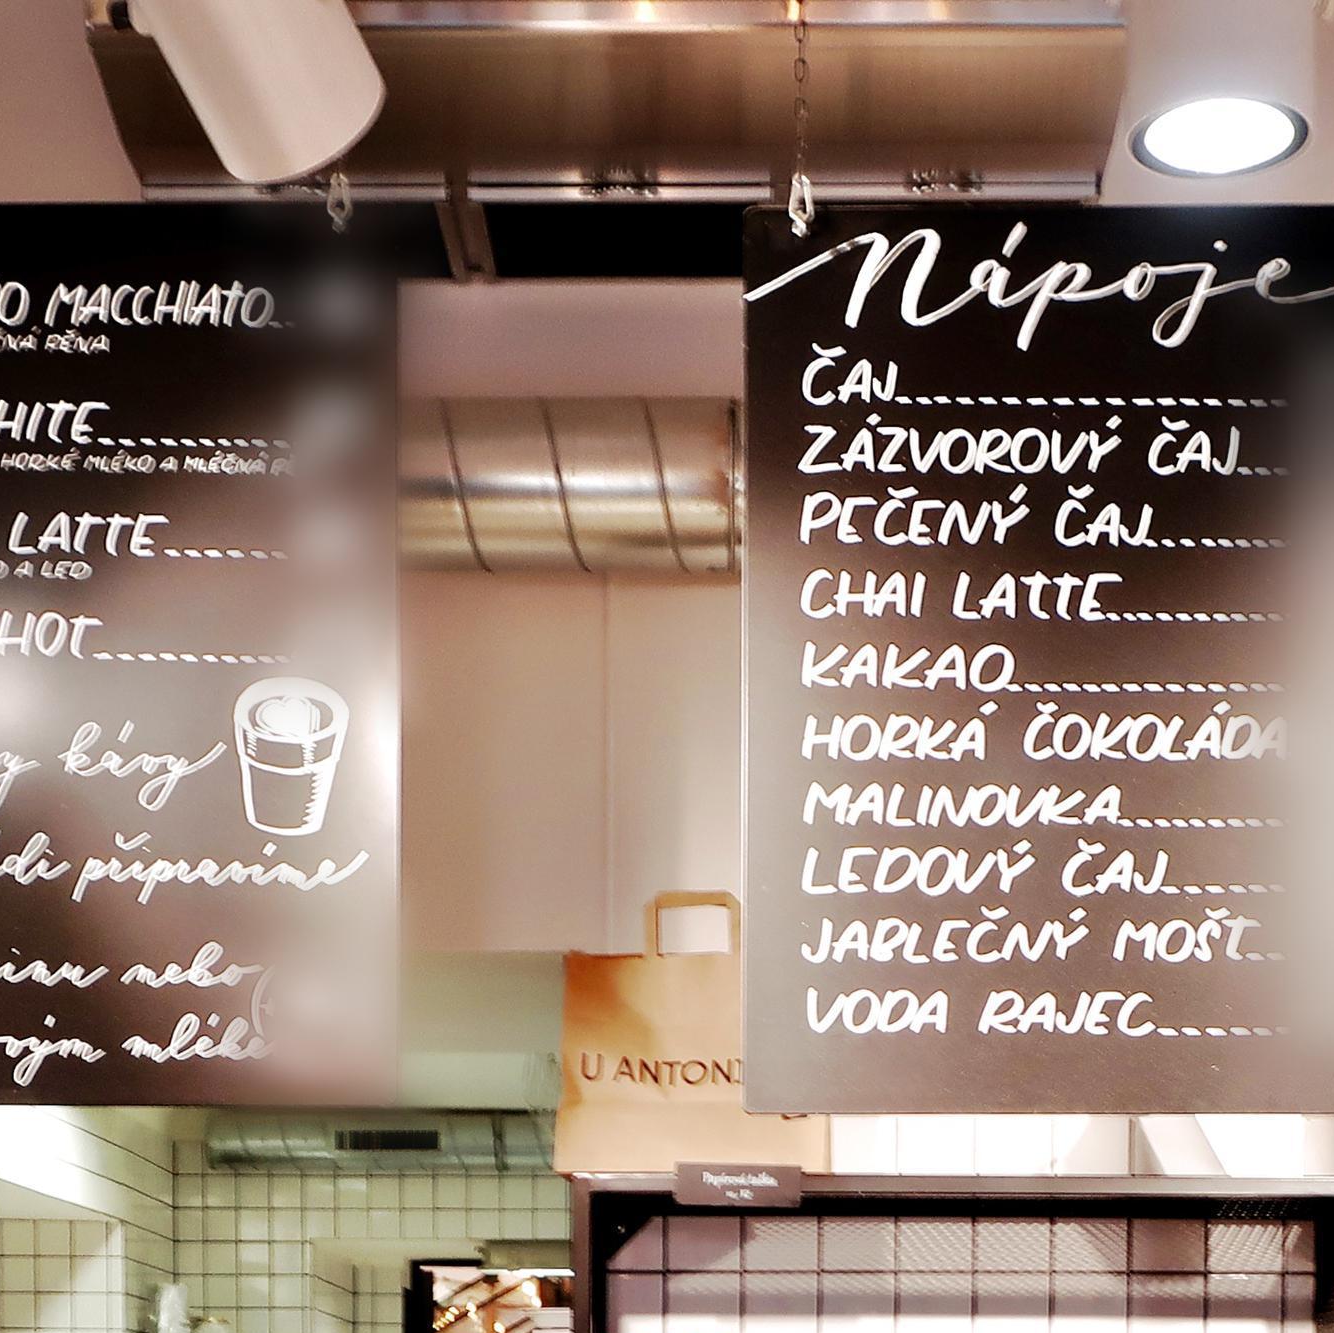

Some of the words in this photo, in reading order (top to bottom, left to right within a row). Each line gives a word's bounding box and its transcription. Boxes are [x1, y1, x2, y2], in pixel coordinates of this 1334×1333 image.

[44, 279, 275, 329] MACCHIATO
[45, 331, 110, 355] PĚNA
[801, 342, 898, 406] ČAJ
[0, 447, 81, 472] HORKÉ
[83, 449, 156, 474] MLÉKO
[159, 456, 178, 472] A
[796, 413, 1122, 475] ZÁZVOROVÝ
[1147, 416, 1239, 476] ČAJ
[8, 511, 170, 557] LATTE
[799, 484, 1029, 546] PEČENÝ
[1054, 484, 1155, 549] ČAJ
[14, 560, 34, 578] A
[40, 560, 93, 580] LED
[799, 569, 925, 620] CHAI
[952, 570, 1122, 622] LATTE
[800, 640, 1016, 693] KAKAO
[801, 700, 1000, 762] HORKÁ
[1022, 700, 1288, 763] ČOKOLÁDA
[59, 720, 227, 811] kávy
[802, 781, 1122, 828] MALINOVKA
[70, 831, 369, 903] připravíme
[801, 839, 1035, 896] LEDOVÝ
[1061, 838, 1171, 897] ČAJ
[800, 906, 1089, 965] JABLEČNÝ
[1112, 906, 1262, 965] MOŠT
[120, 941, 264, 987] nebo
[806, 986, 949, 1037] VODA
[978, 989, 1158, 1037] RAJEC
[581, 1052, 604, 1082] U
